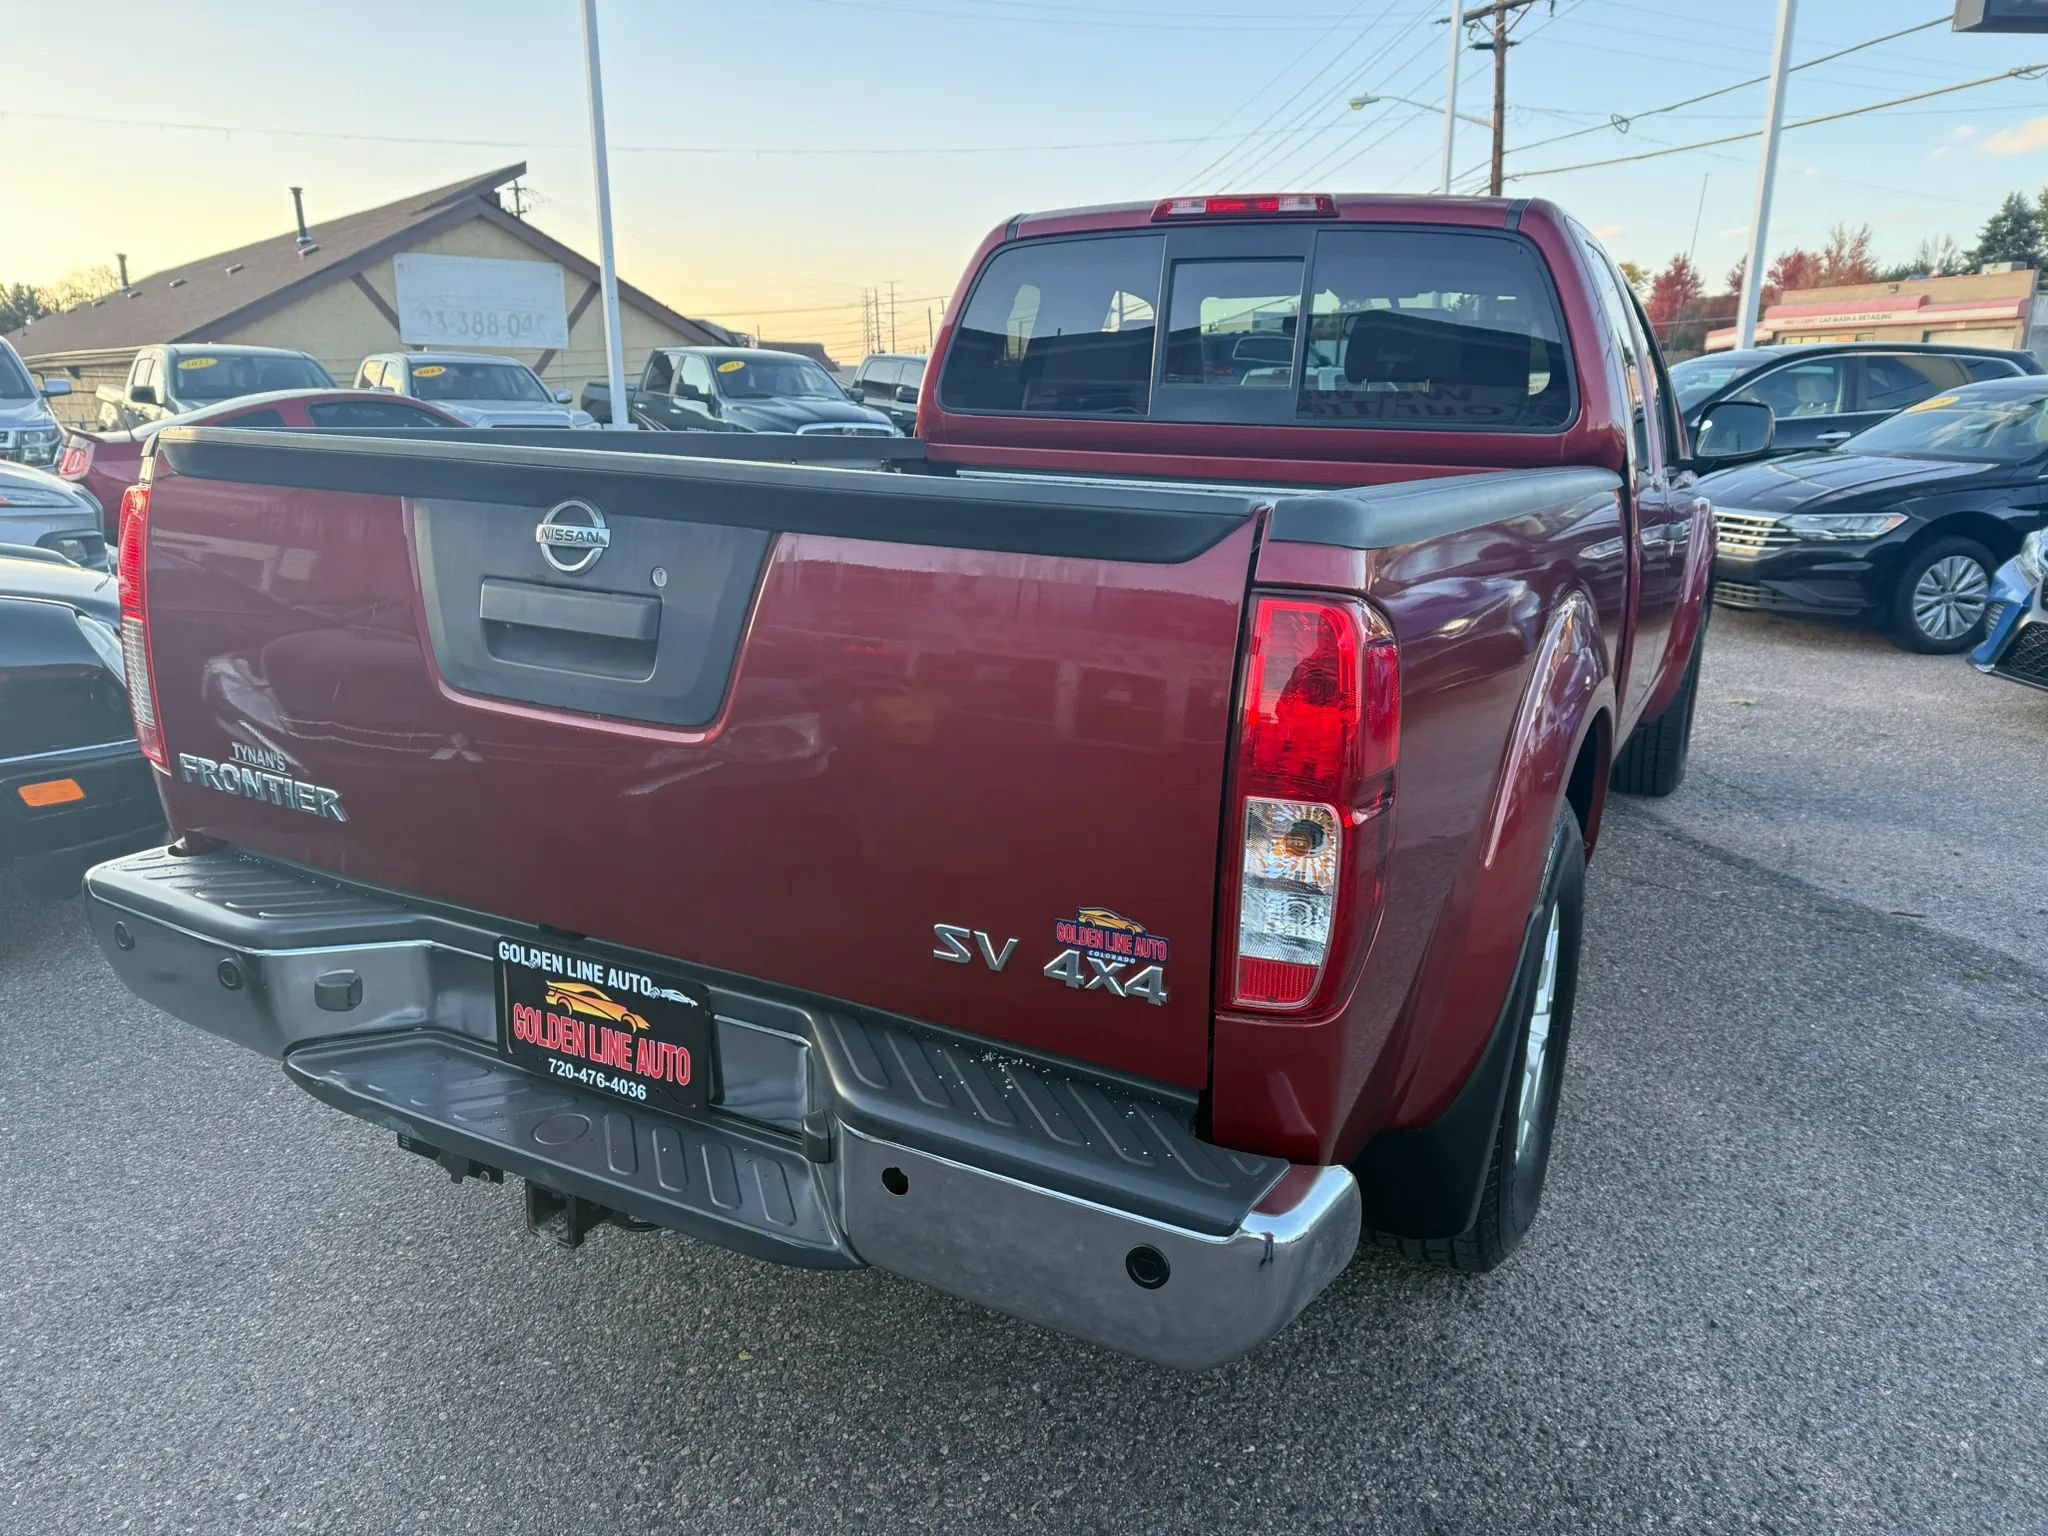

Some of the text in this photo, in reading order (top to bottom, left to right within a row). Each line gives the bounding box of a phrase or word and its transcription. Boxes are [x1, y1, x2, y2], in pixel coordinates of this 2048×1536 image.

[541, 528, 599, 543] NISSAN
[231, 742, 287, 772] TYNAN'S
[179, 752, 350, 822] FRONTIER
[933, 923, 1019, 972] SV
[1056, 921, 1168, 961] GOLDEN LINE AUTO
[1088, 950, 1136, 964] COLORADO
[498, 941, 652, 996] GOLDEN LINE AUTO
[513, 1002, 691, 1086] GOLDEN LINE AUTO
[548, 1058, 647, 1100] 720-476-4036
